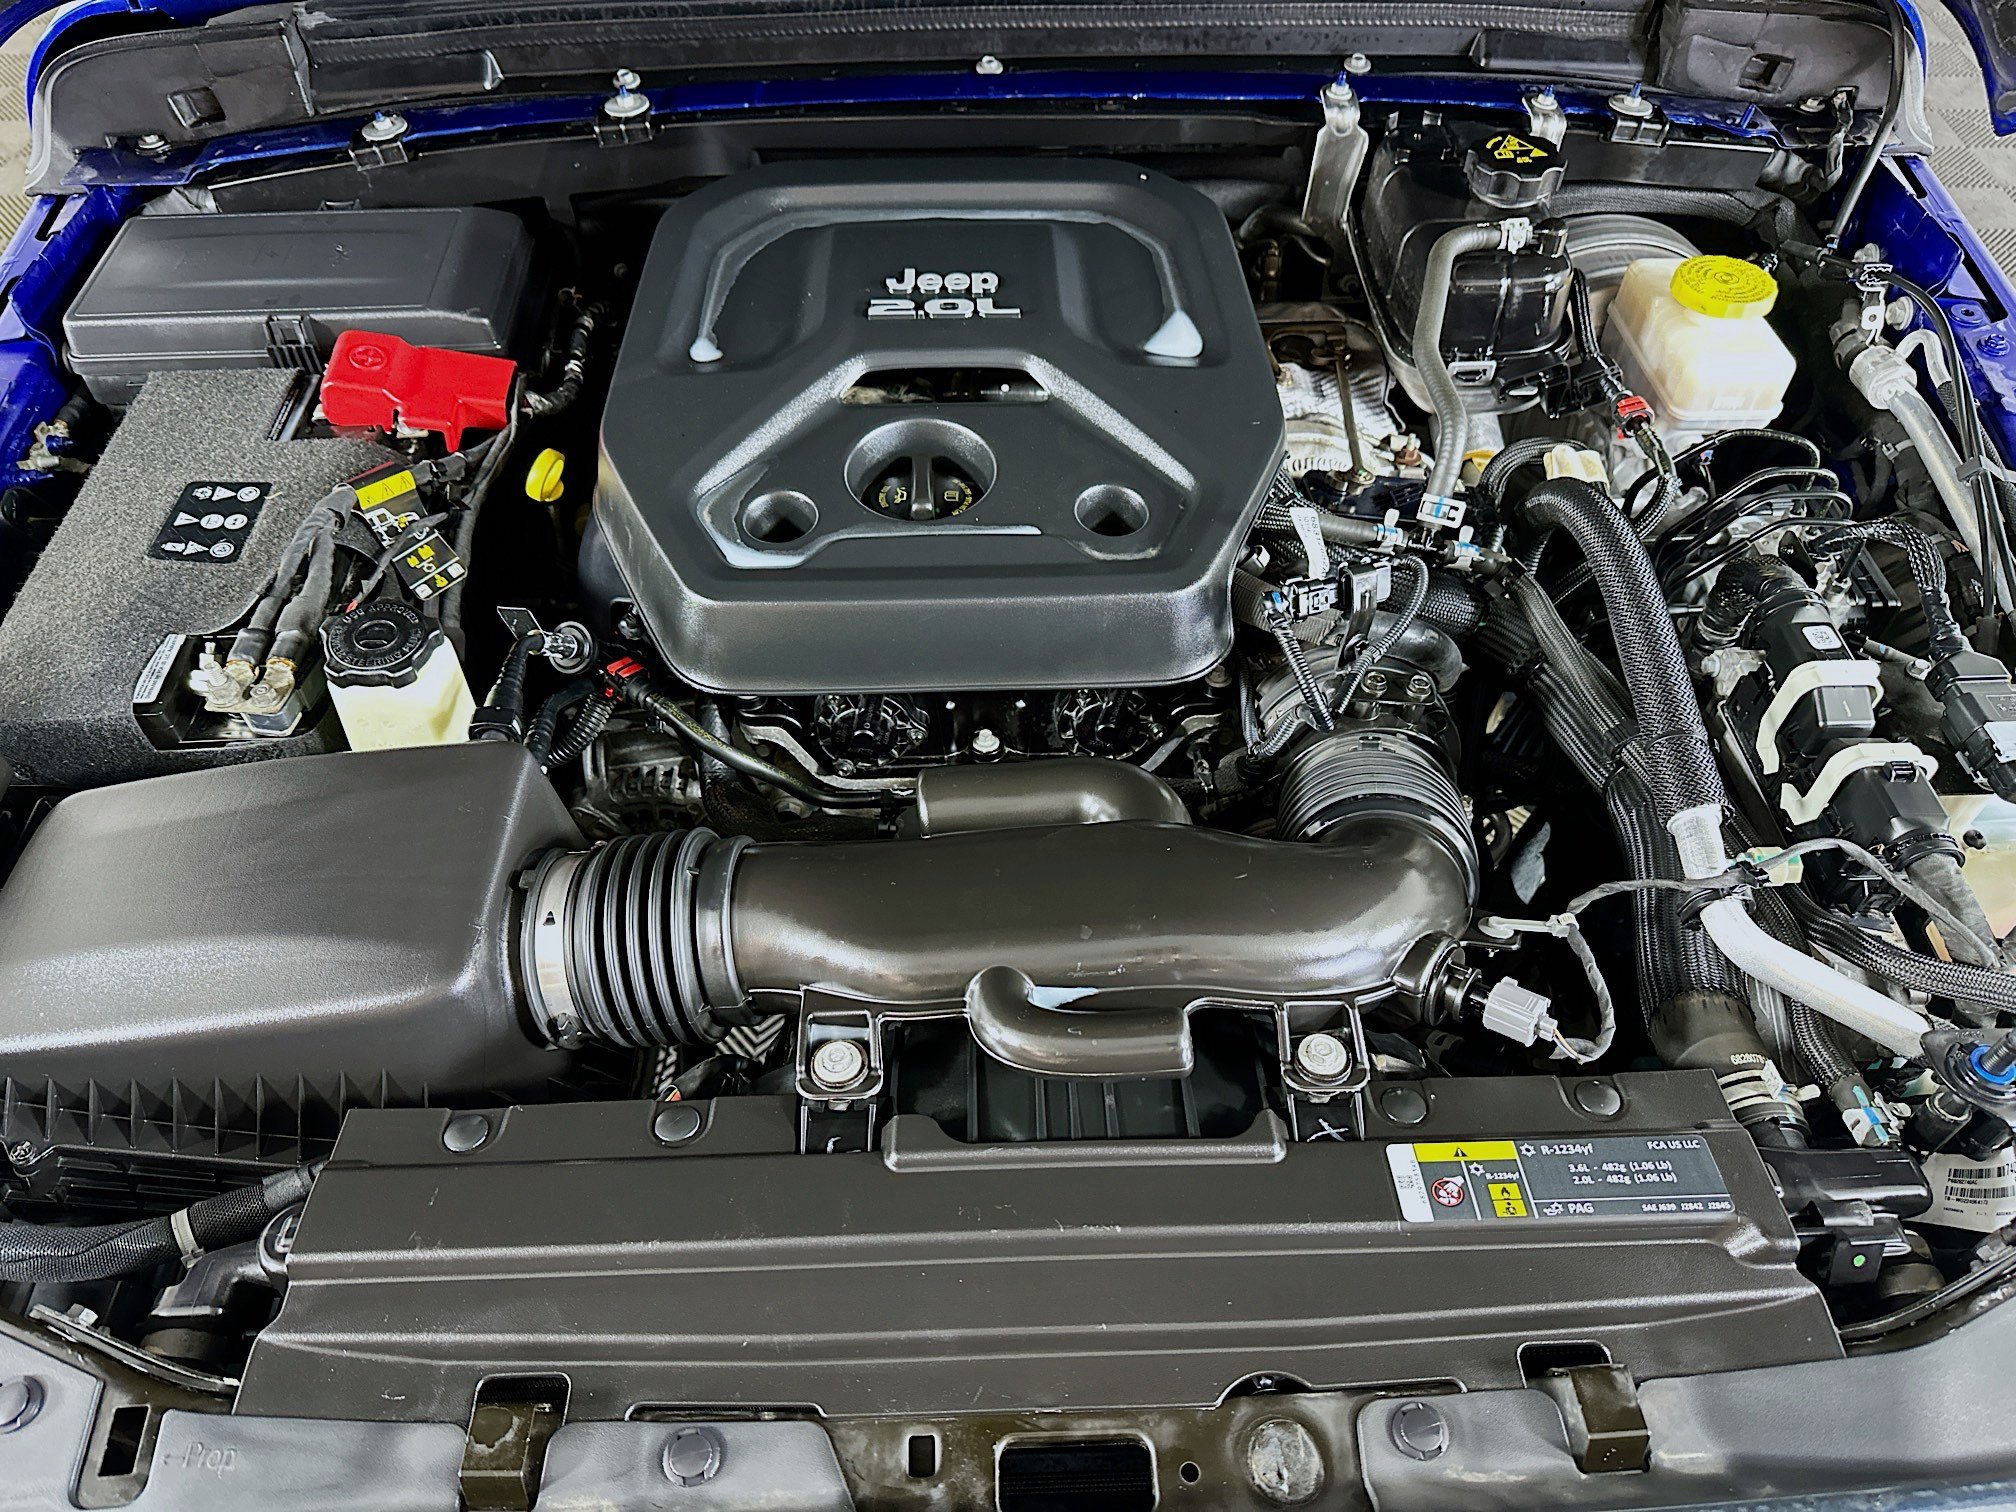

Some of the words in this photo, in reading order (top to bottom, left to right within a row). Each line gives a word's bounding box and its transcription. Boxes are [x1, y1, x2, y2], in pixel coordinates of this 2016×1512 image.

[885, 267, 999, 298] Jeep
[868, 298, 1022, 320] 2.0L
[368, 603, 420, 624] APPROVED
[344, 652, 402, 666] STEERING
[1540, 1143, 1594, 1156] R-1234yf
[1647, 1141, 1667, 1150] FCA
[1668, 1140, 1683, 1150] US
[1683, 1139, 1701, 1149] LLC
[1568, 1163, 1591, 1173] 3.6L
[1601, 1162, 1627, 1173] 482g
[1629, 1160, 1656, 1173] (1.06
[1656, 1159, 1673, 1171] Lb)
[1573, 1175, 1595, 1185] 2.0L
[1606, 1174, 1632, 1185] 482g
[1633, 1172, 1660, 1184] (1.06
[1661, 1171, 1678, 1184] Lb)
[1567, 1202, 1595, 1215] PAG
[1641, 1203, 1659, 1212] SAE
[182, 1442, 237, 1478] Prop
